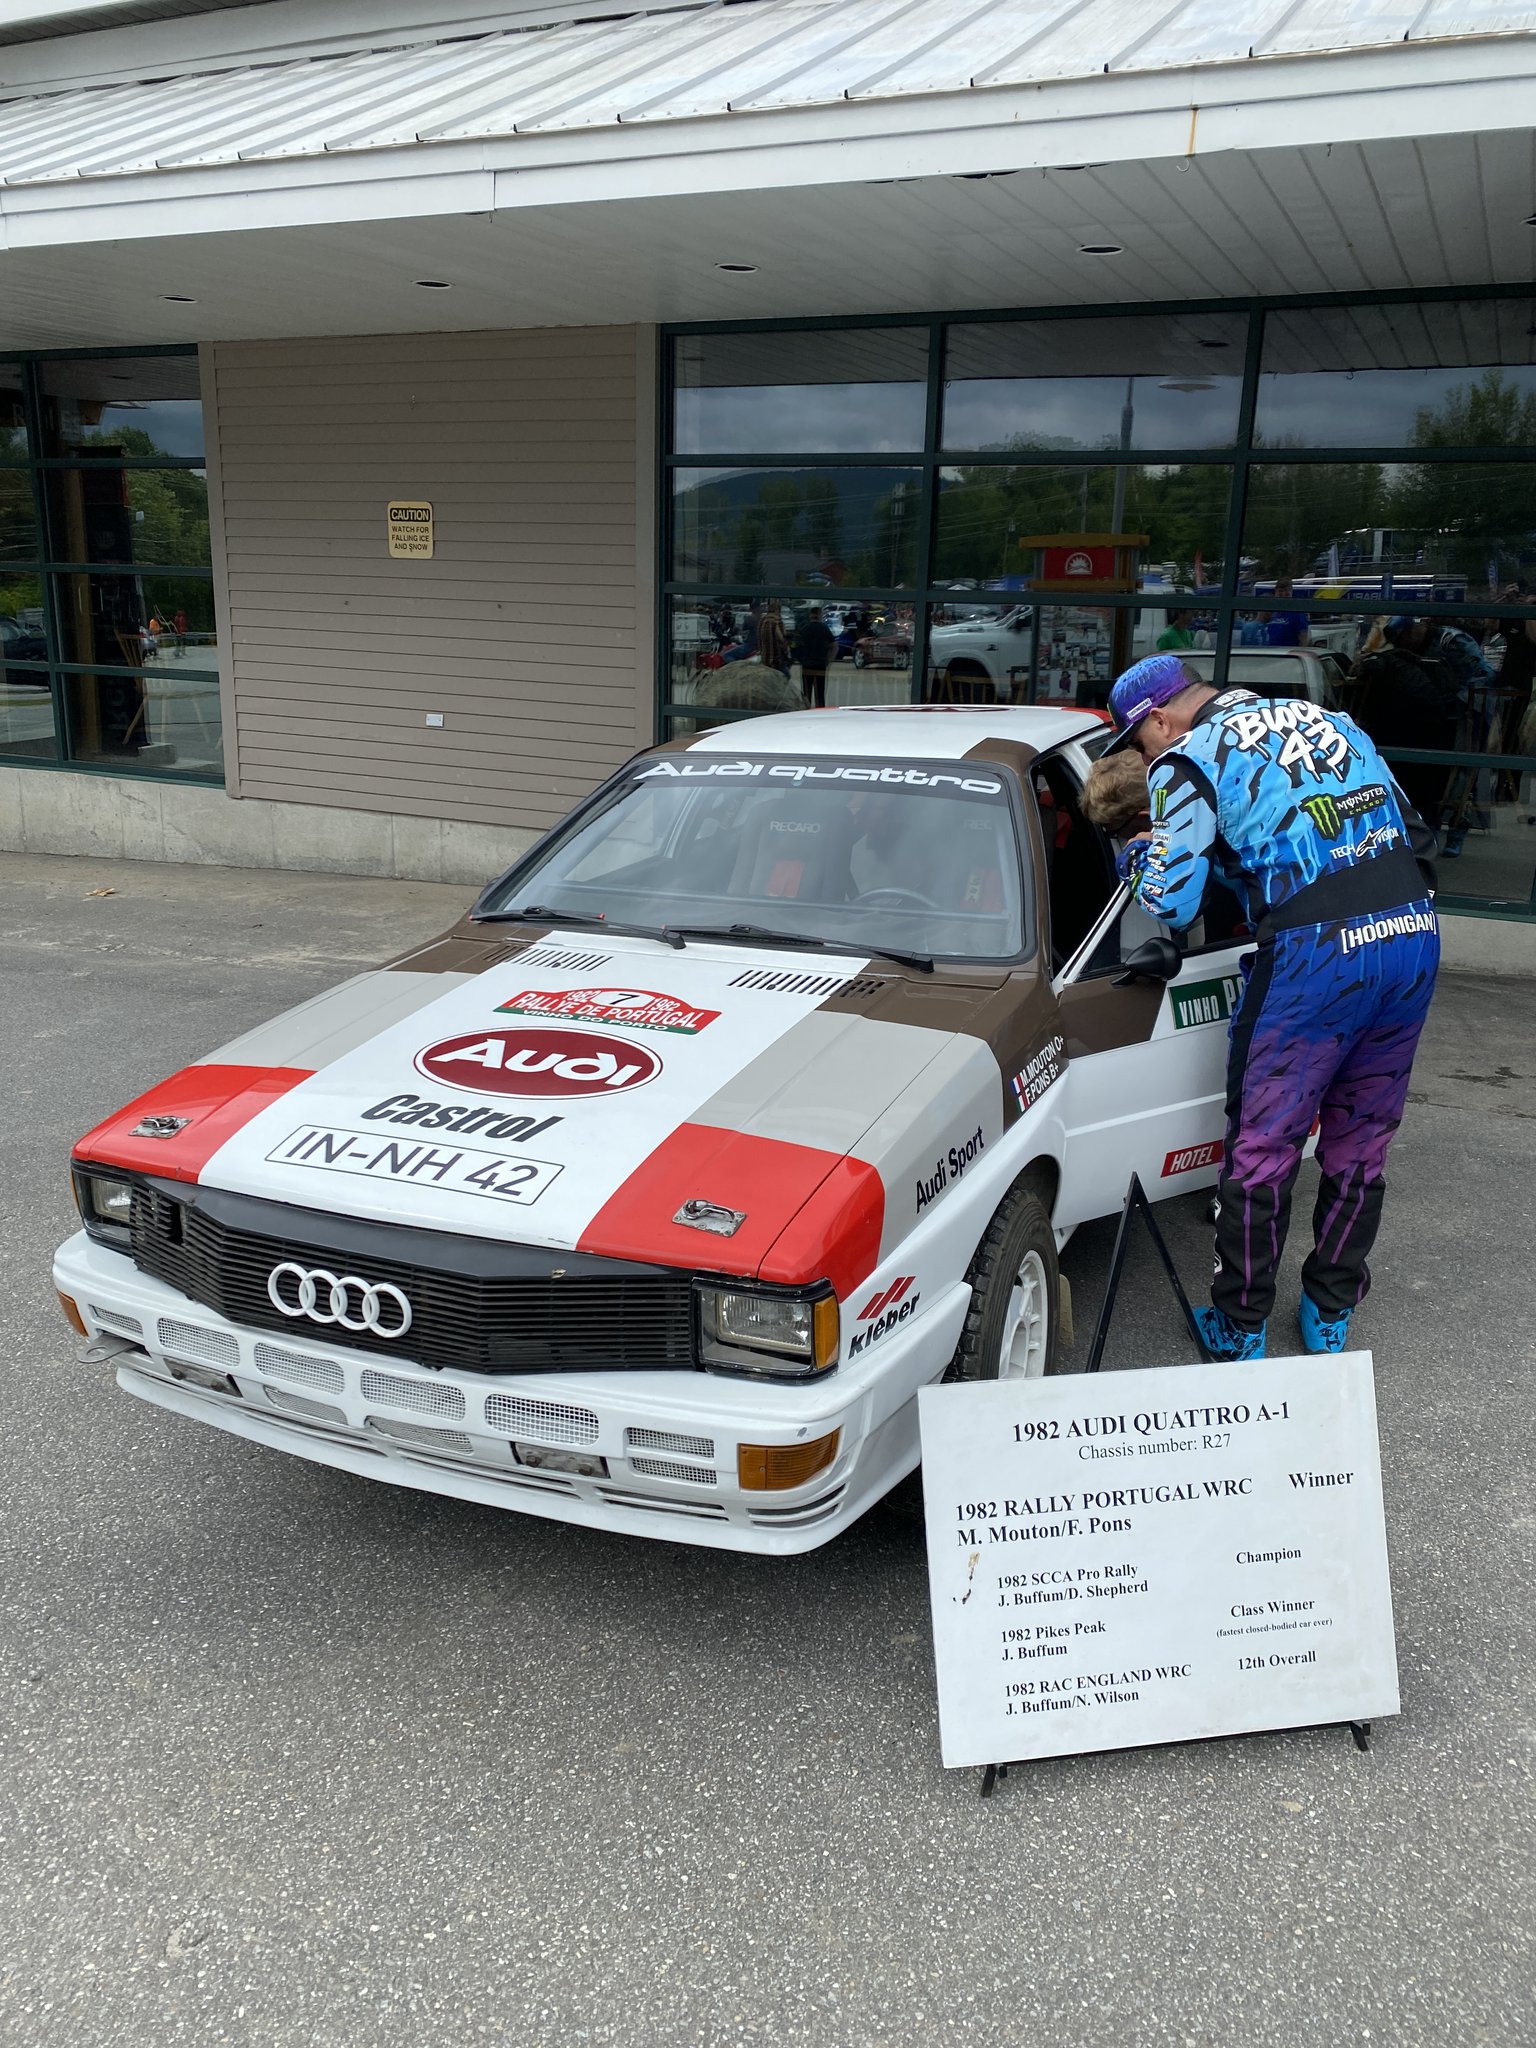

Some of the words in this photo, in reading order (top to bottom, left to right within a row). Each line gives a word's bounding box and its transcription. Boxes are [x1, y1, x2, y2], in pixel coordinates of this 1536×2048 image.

[391, 509, 429, 521] CAUTION
[391, 534, 418, 542] FALLING
[409, 543, 428, 551] SNOW
[1278, 721, 1352, 781] 43
[632, 761, 764, 780] Audi
[768, 765, 1002, 795] quattro
[770, 821, 822, 834] RECARO
[1329, 843, 1356, 859] TECH
[1377, 827, 1400, 844] VISION
[509, 993, 581, 1012] RALLYE
[575, 1004, 606, 1016] DE
[602, 1008, 704, 1028] PORTUGAL
[562, 990, 601, 1003] 1982
[609, 993, 640, 1005] 7
[645, 997, 681, 1011] 1982
[1178, 994, 1220, 1026] VINHO
[578, 1015, 604, 1023] DO
[608, 1019, 668, 1031] PORTO
[428, 1038, 643, 1086] Audi
[1019, 1041, 1057, 1088] M.MOUTON
[1024, 1069, 1051, 1105] F.PONS
[1048, 1062, 1059, 1080] B+
[360, 1094, 566, 1142] Castrol
[285, 1131, 464, 1181] IN-NH
[463, 1160, 539, 1196] 42
[916, 1158, 947, 1214] Audi
[948, 1125, 984, 1178] Sport
[1169, 1145, 1213, 1173] HOTEL
[1013, 1420, 1061, 1443] 1982
[1065, 1414, 1127, 1439] AUDI
[1133, 1404, 1251, 1435] QUATTRO
[1255, 1400, 1290, 1422] A-1
[1078, 1441, 1135, 1461] Chassis
[1137, 1437, 1198, 1456] number:
[1201, 1432, 1231, 1450] R27
[1287, 1471, 1355, 1490] Winner
[955, 1501, 998, 1522] 1982
[1003, 1493, 1076, 1517] RALLY
[1082, 1483, 1200, 1510] PORTUGAL
[1201, 1477, 1253, 1498] WRC
[957, 1528, 983, 1547] M.
[988, 1518, 1084, 1544] Mouton/F.
[1088, 1516, 1132, 1534] Pons
[1235, 1547, 1302, 1565] Champion
[997, 1573, 1028, 1589] 1982
[1031, 1570, 1074, 1586] SCCA
[1077, 1568, 1101, 1581] Pro
[1103, 1563, 1138, 1580] Rally
[997, 1594, 1010, 1607] J.
[1013, 1586, 1083, 1606] Buffum/D.
[1086, 1579, 1149, 1599] Shepherd
[1230, 1604, 1265, 1618] Class
[1266, 1599, 1316, 1614] Winner
[1001, 1627, 1032, 1643] 1982
[1035, 1625, 1071, 1640] Pikes
[1074, 1620, 1107, 1636] Peak
[1215, 1627, 1244, 1638] (fastest
[1245, 1620, 1298, 1634] closed-bodied
[1298, 1620, 1311, 1629] car
[1312, 1618, 1333, 1627] ever)
[1001, 1648, 1014, 1662] J.
[1017, 1644, 1068, 1660] Buffum
[1238, 1655, 1266, 1671] 12th
[1268, 1649, 1317, 1667] Overall
[1005, 1681, 1036, 1698] 1982
[1039, 1677, 1073, 1694] RAC
[1076, 1668, 1152, 1692] ENGLAND
[1154, 1664, 1192, 1680] WRC
[1005, 1702, 1018, 1716] J.
[1021, 1694, 1092, 1714] Buffum/N.
[1093, 1690, 1140, 1705] Wilson
